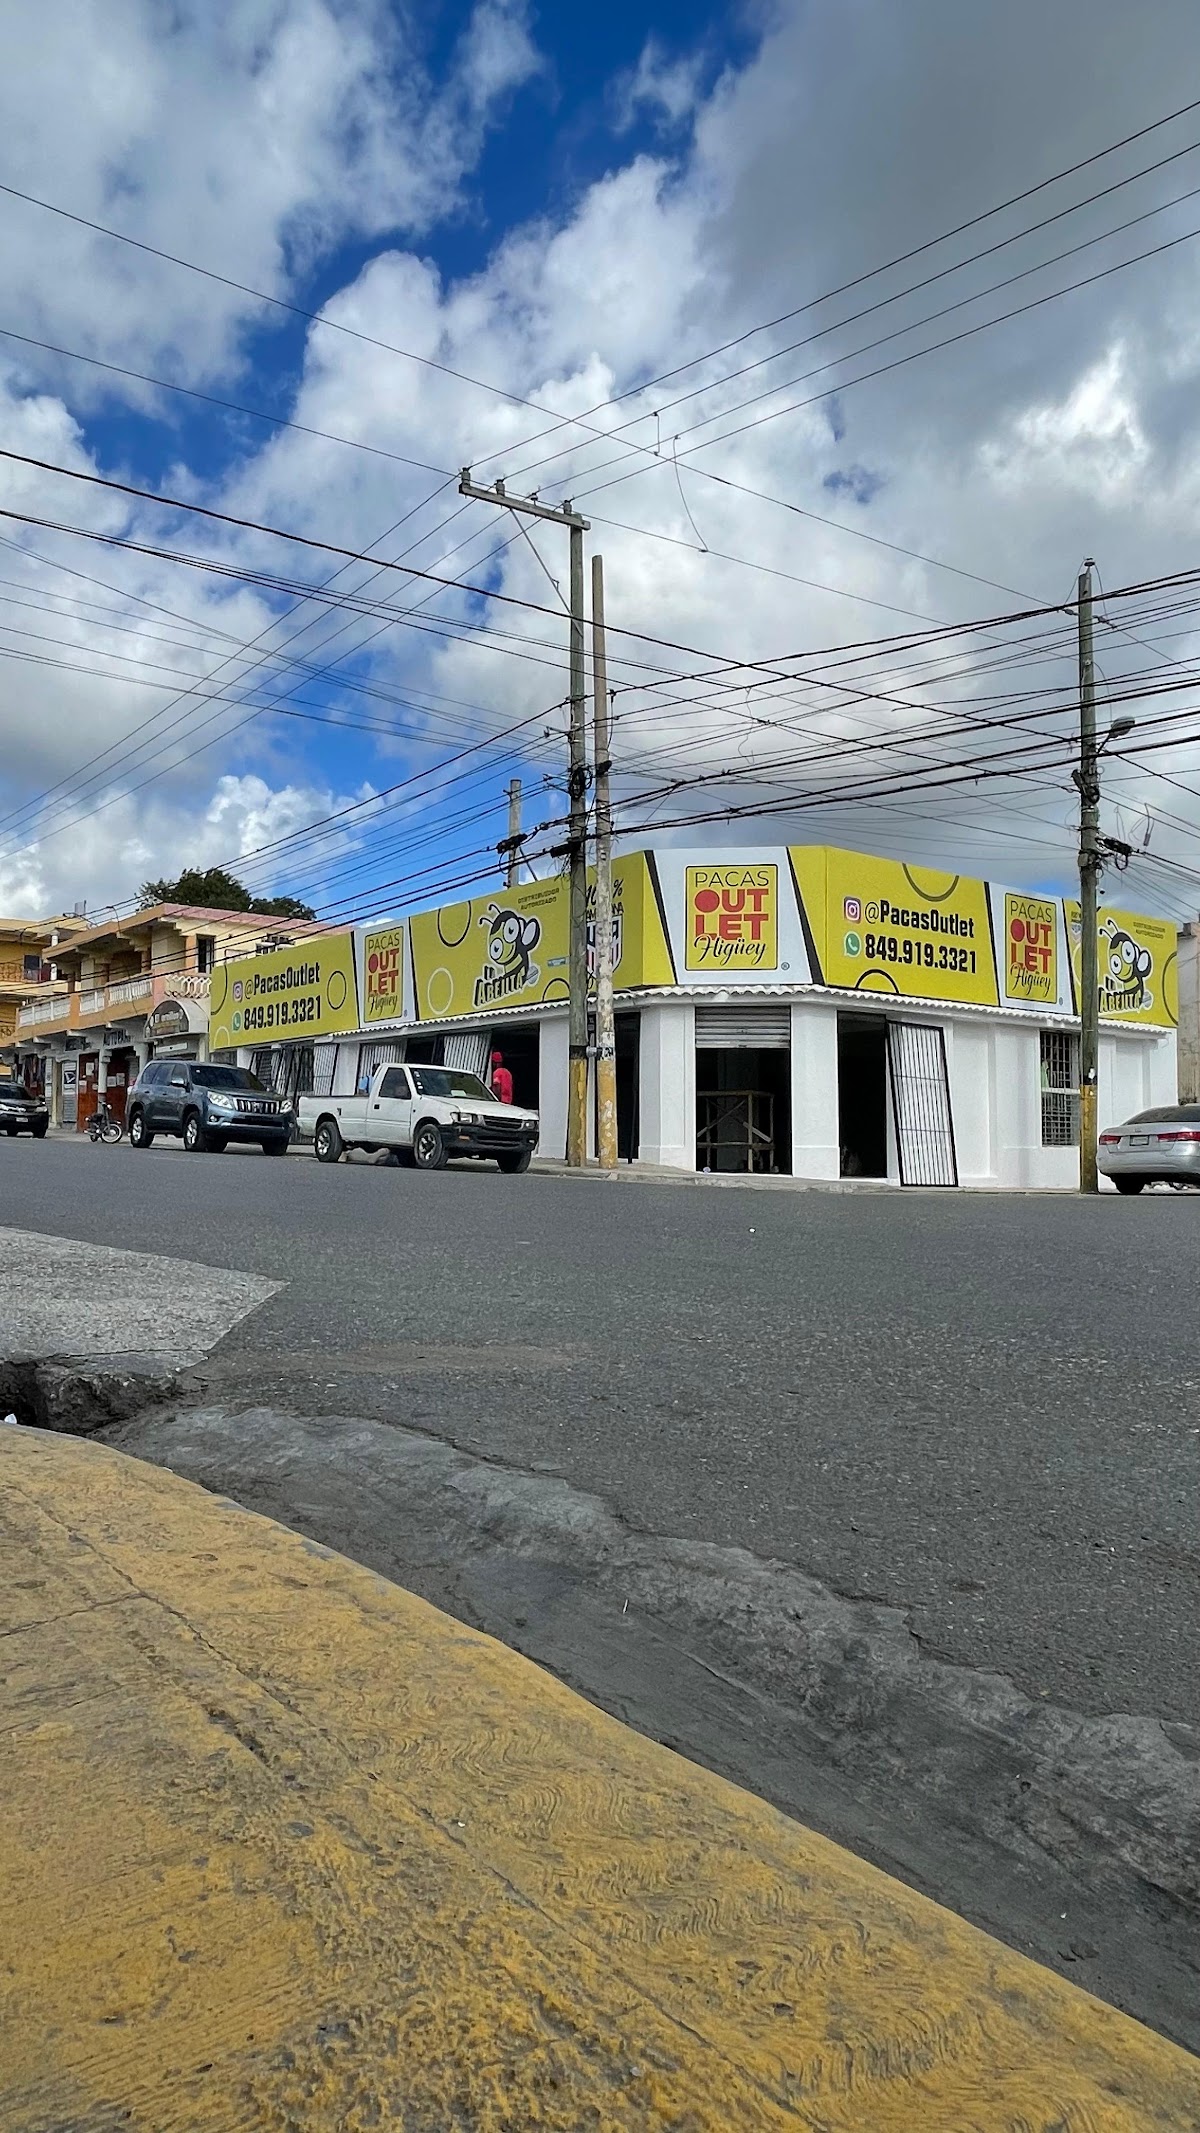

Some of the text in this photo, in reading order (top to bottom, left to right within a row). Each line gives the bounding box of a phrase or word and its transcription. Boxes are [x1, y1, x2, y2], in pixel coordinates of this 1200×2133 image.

[694, 870, 769, 888] PACAS
[694, 888, 769, 913] OUT
[1010, 900, 1053, 923] PACAS
[695, 913, 769, 941] LET
[864, 899, 975, 938] @PacasOutlet
[1010, 918, 1052, 947] OUT
[368, 932, 400, 954] PACAS
[693, 935, 767, 966] Higüey
[864, 933, 976, 974] 849.919.3321
[368, 948, 400, 974] OUT
[1010, 942, 1052, 974] LET
[244, 961, 320, 1000] @PacasOutlet
[368, 969, 399, 995] LET
[243, 994, 321, 1031] 849.919.3321
